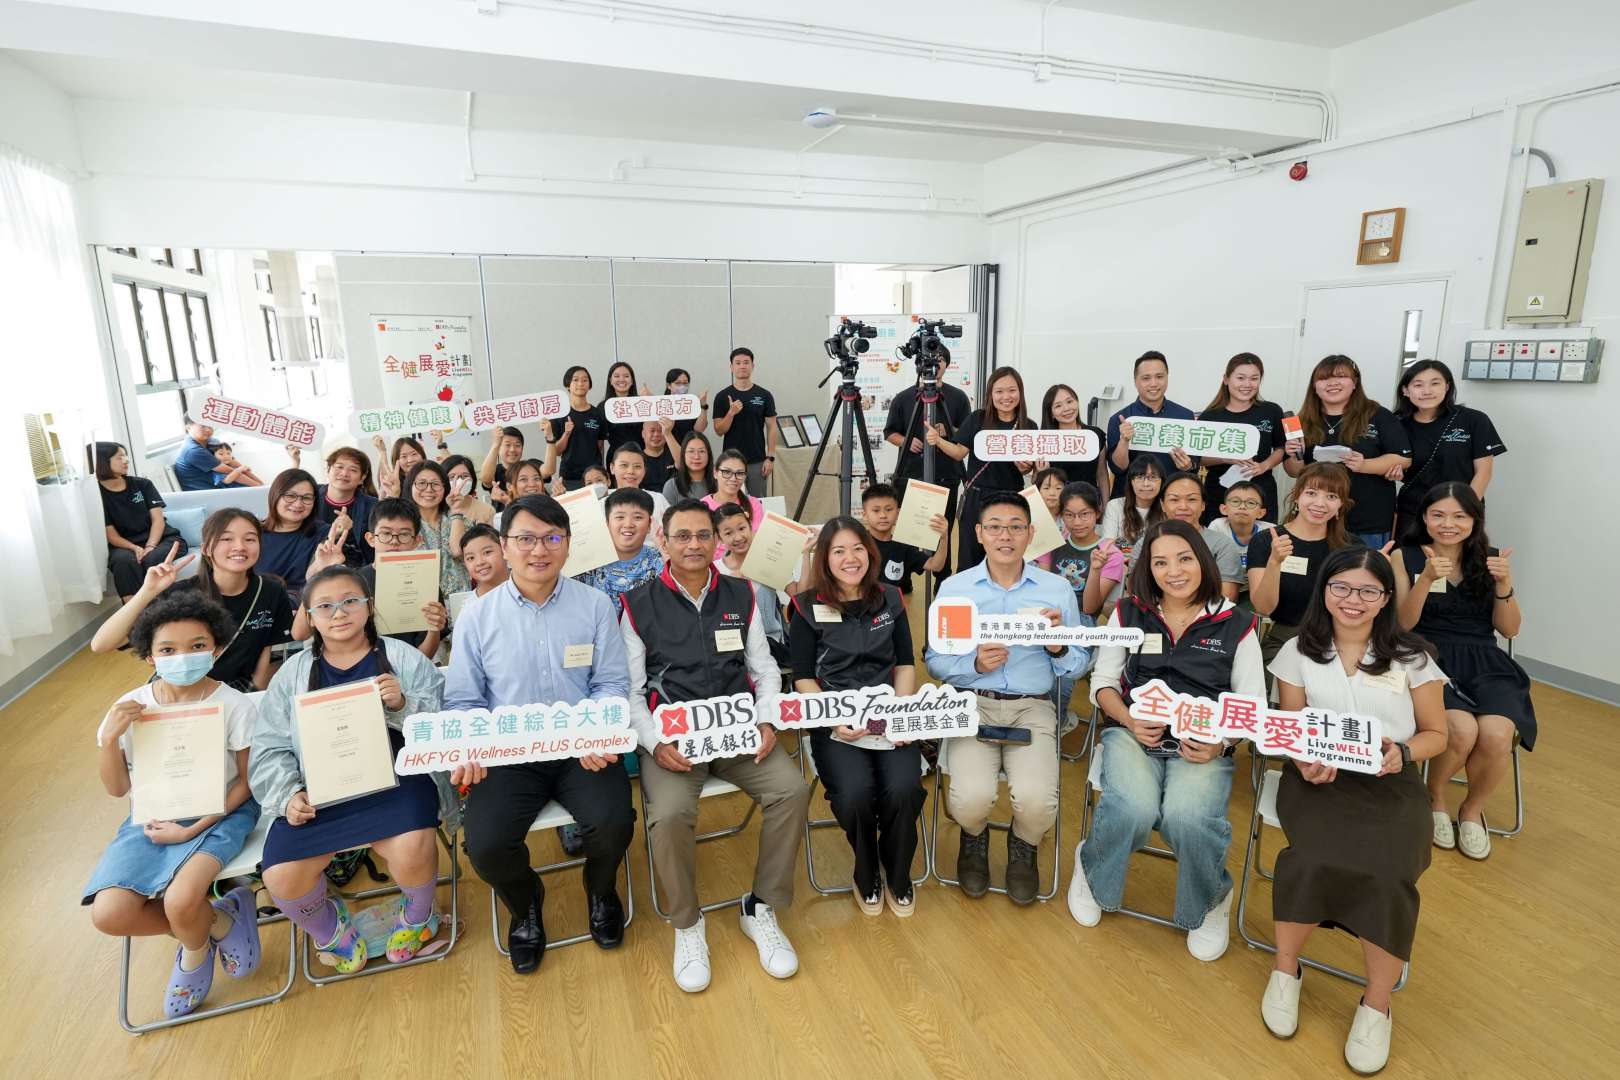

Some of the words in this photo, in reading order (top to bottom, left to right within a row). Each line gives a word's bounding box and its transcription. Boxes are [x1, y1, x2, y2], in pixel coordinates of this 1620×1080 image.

[384, 354, 471, 378] 全健展愛計劃
[202, 397, 316, 445] 運動體能
[360, 406, 450, 433] 精神健康
[473, 394, 561, 426] 共享廚房
[613, 398, 693, 418] 社會處方
[986, 434, 1087, 455] 營養攝取
[1132, 422, 1247, 454] 營養市集
[980, 622, 1046, 631] 香港青年協會
[980, 632, 994, 640] the
[994, 632, 1031, 641] hongkong
[1034, 632, 1074, 641] federation
[1075, 632, 1084, 641] of
[1085, 632, 1109, 642] youth
[1110, 634, 1139, 642] groups
[411, 704, 625, 742] 青協全健綜合大樓
[691, 698, 754, 731] DBS
[805, 695, 857, 720] DBS
[859, 691, 968, 727] Foundation
[892, 712, 970, 734] 星展基金會
[1138, 685, 1372, 754] 全健展愛計劃
[404, 750, 460, 768] HKFYG
[467, 746, 526, 762] Wellness
[531, 740, 570, 754] PLUS
[574, 735, 631, 751] Complex
[684, 729, 757, 758] 星展銀行
[1307, 738, 1373, 757] LiveWELL
[1307, 749, 1373, 767] Programme
